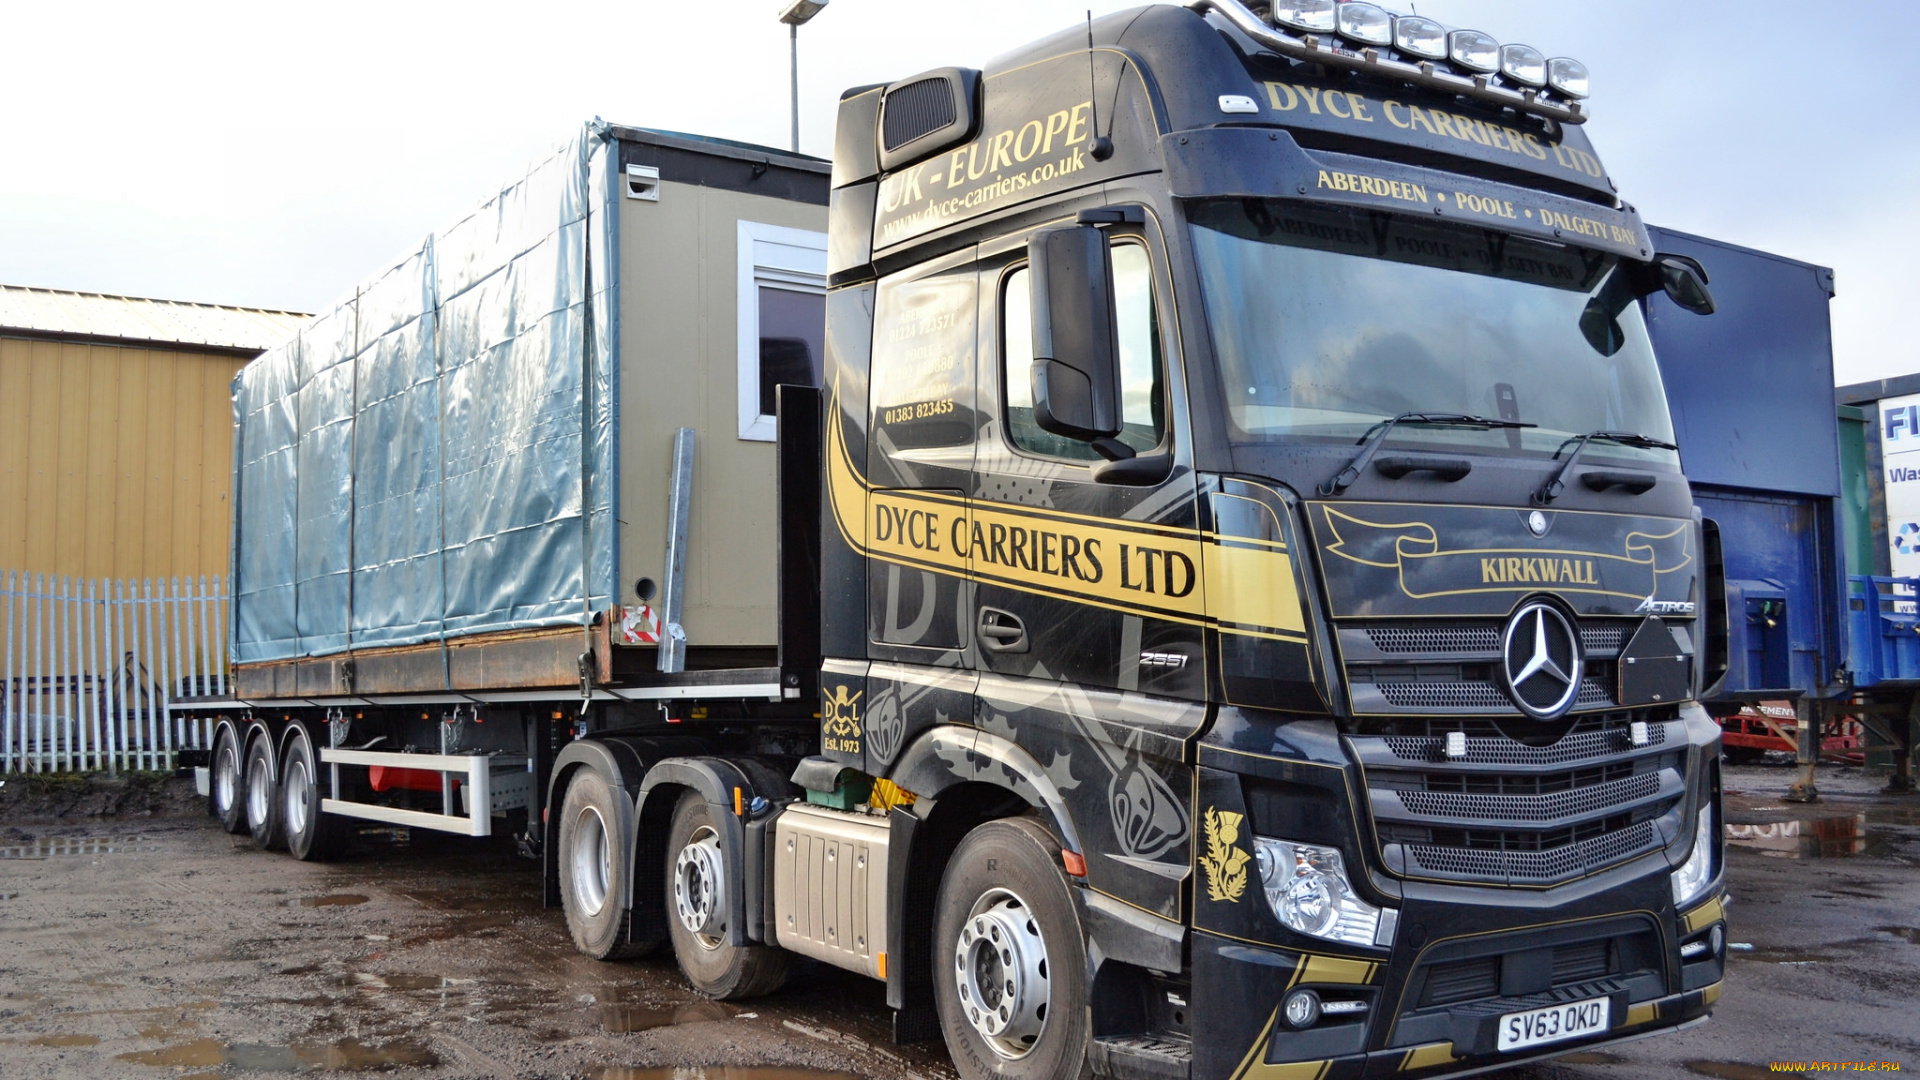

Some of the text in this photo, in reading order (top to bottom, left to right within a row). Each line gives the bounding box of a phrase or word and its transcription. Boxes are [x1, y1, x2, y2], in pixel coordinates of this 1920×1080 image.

[1263, 81, 1601, 177] DYCE CARRIERS LTD
[884, 164, 926, 213] UK
[947, 101, 1091, 189] EUROPE
[1318, 170, 1636, 247] ABERDEEN POOLE DALGETY BAY
[885, 398, 954, 425] 01383 823455
[875, 504, 1196, 598] DYCE CARRIERS LTD
[1481, 557, 1599, 585] KIRKWALL
[1634, 595, 1695, 612] ACTROS
[1140, 652, 1188, 668] 2551
[825, 738, 860, 754] Est. 1973
[1508, 1002, 1601, 1043] SV63 OKD
